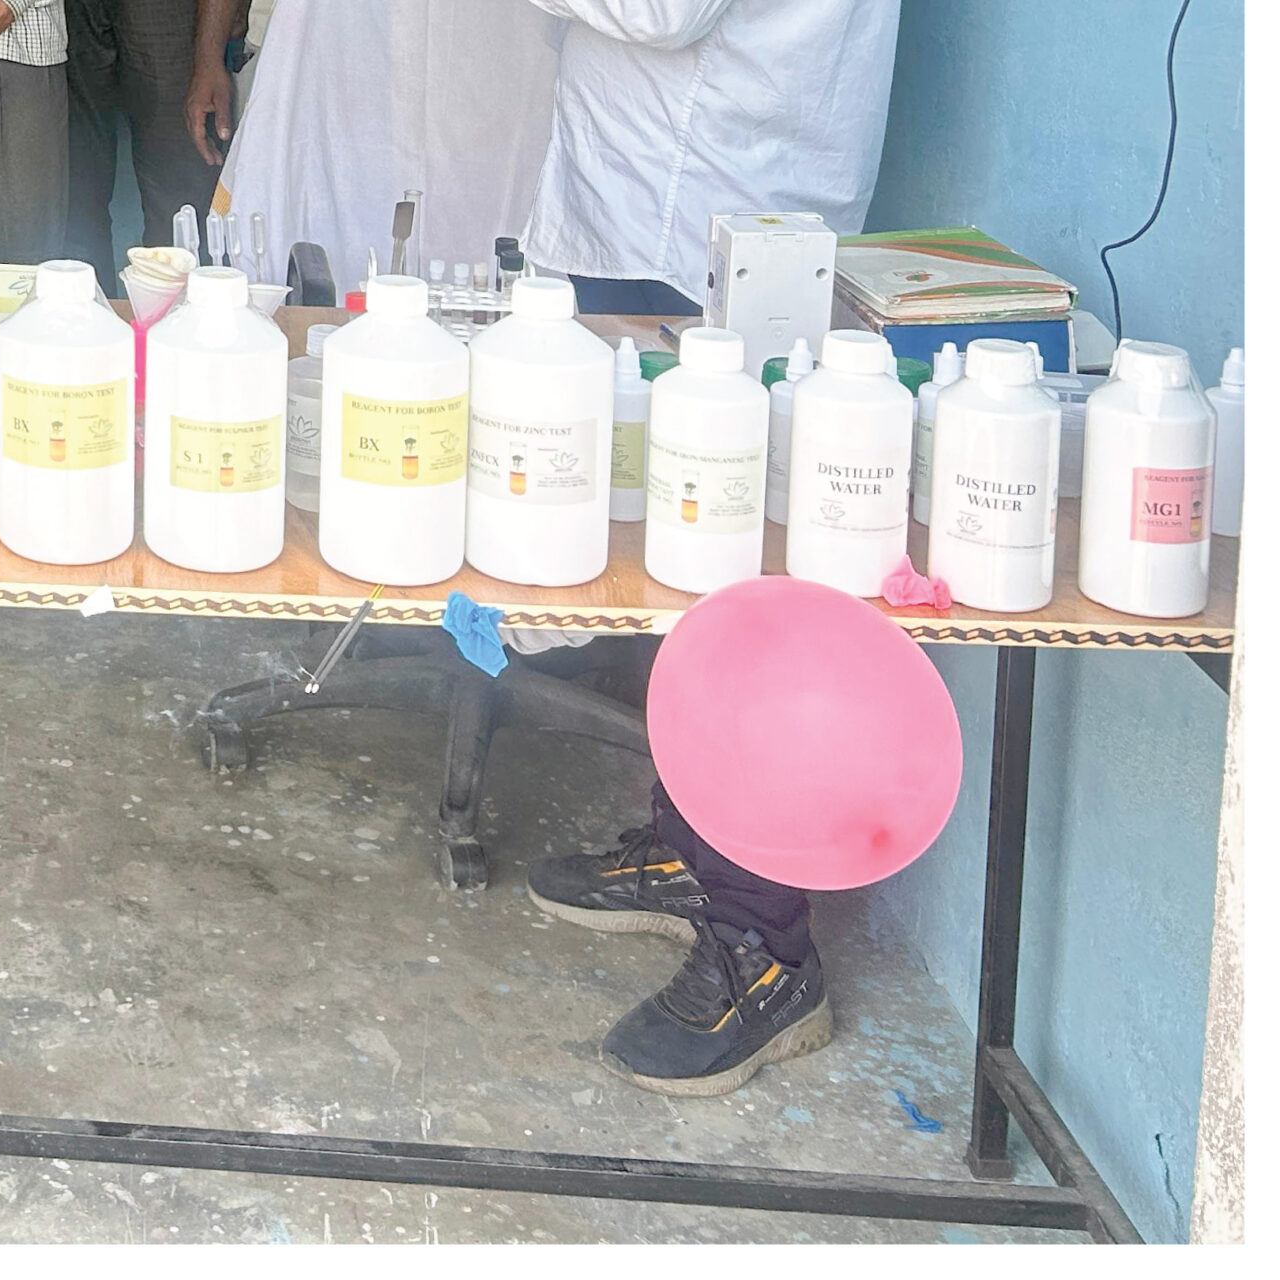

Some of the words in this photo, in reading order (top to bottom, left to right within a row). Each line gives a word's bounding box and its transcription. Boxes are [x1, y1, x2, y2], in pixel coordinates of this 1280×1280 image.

[351, 400, 393, 414] REAGENT
[395, 405, 415, 415] FOR
[416, 405, 447, 415] BORON
[13, 416, 29, 433] BX
[503, 423, 521, 433] FOR
[522, 425, 547, 435] ZINC
[548, 426, 573, 437] TEST
[359, 436, 381, 452] BX
[817, 462, 895, 480] DISTILLED
[830, 480, 883, 496] WATER
[955, 473, 1037, 496] DISTILLED
[967, 492, 1023, 512] WATER
[1143, 501, 1183, 517] MG1
